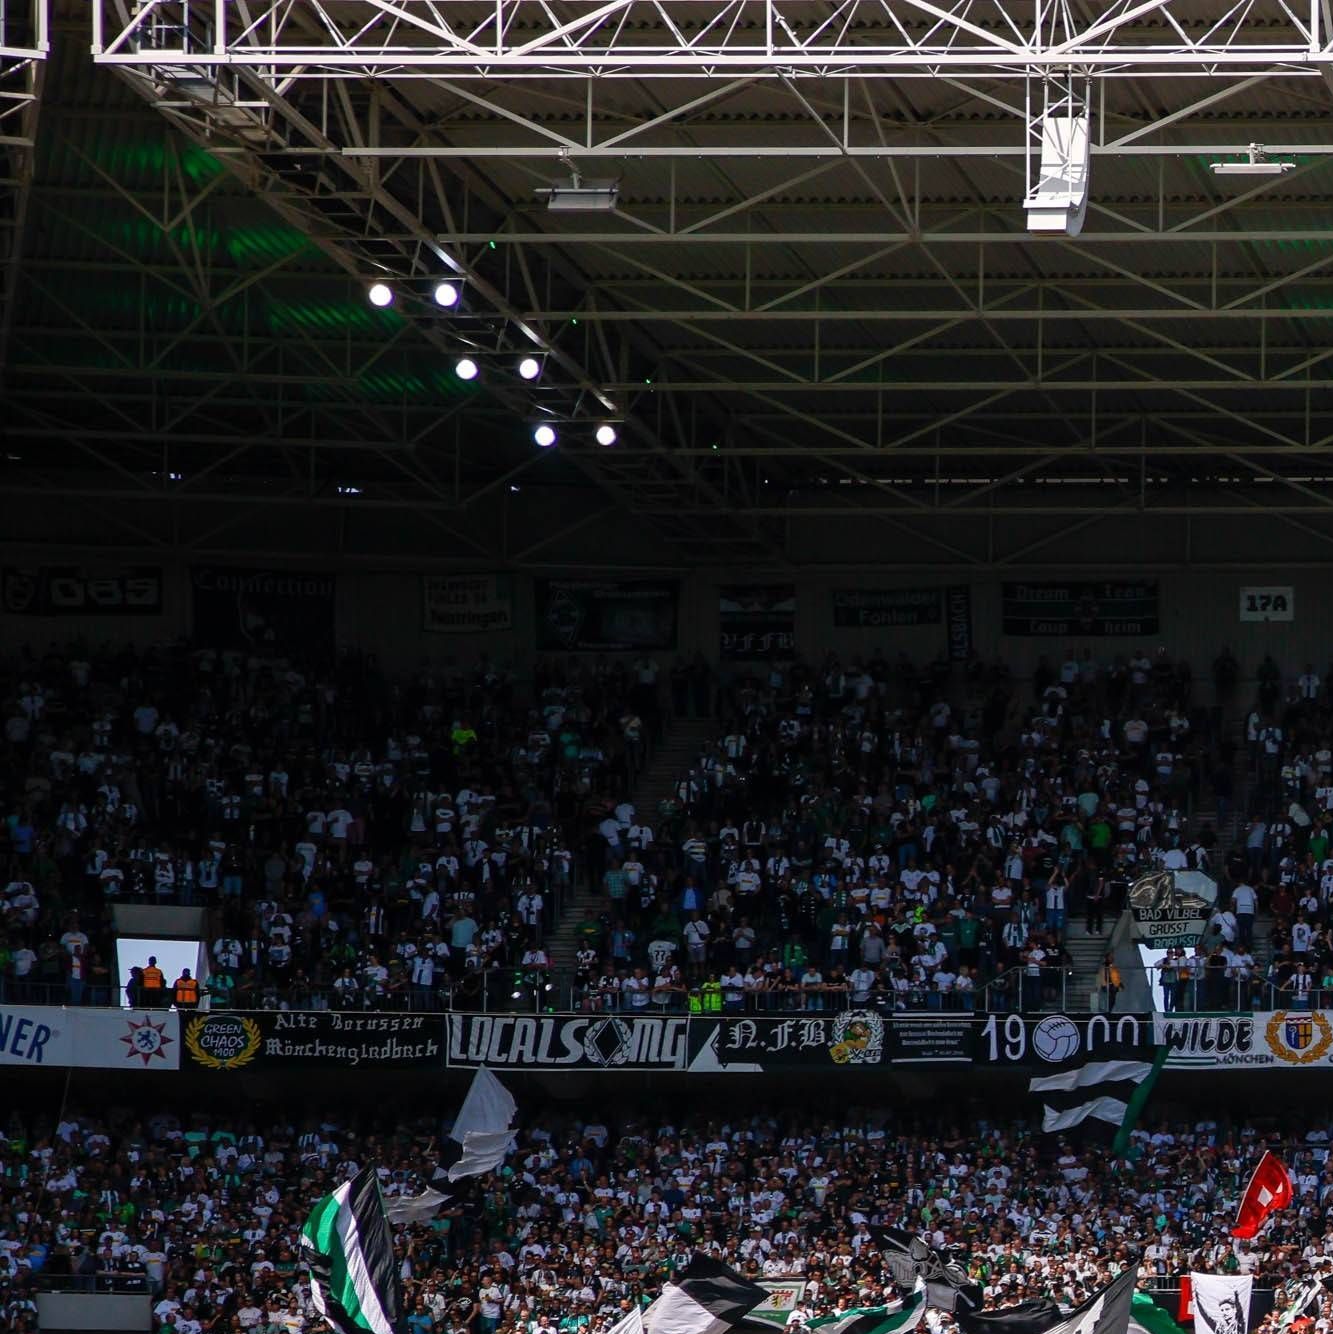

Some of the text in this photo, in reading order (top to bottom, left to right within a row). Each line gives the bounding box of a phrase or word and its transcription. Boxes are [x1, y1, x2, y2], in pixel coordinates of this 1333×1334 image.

[1246, 594, 1287, 612] 17A
[1138, 907, 1201, 921] BAD VILBEL
[204, 1022, 243, 1035] GREEN
[273, 1012, 425, 1034] Alte Borussen
[200, 1035, 246, 1049] CHAOS
[1163, 1017, 1255, 1054] WILDE
[265, 1037, 439, 1065] Mönchengladbach
[1215, 1053, 1275, 1066] MÖNCHEN
